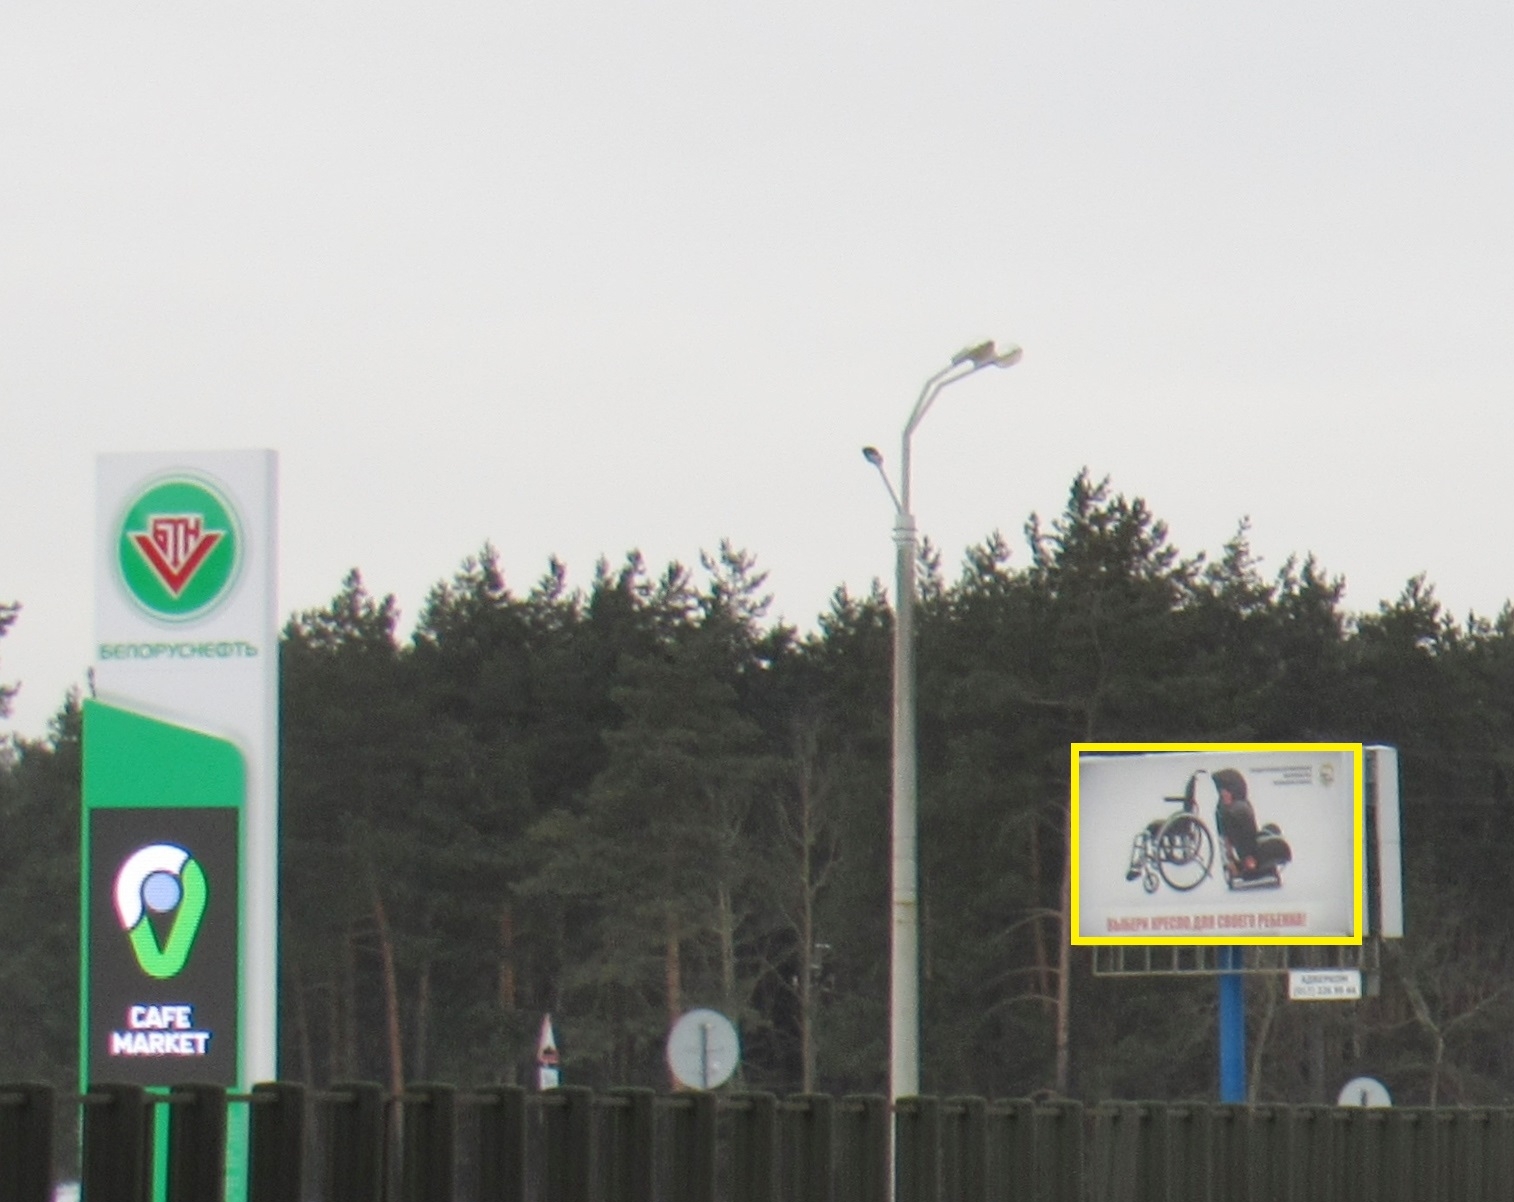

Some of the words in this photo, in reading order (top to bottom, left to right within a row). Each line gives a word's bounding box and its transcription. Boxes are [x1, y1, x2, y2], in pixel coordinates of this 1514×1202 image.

[99, 642, 258, 660] БЕЛОРУСНЕФТЬ
[128, 1004, 193, 1029] CAFE
[110, 1030, 211, 1056] MARKET
